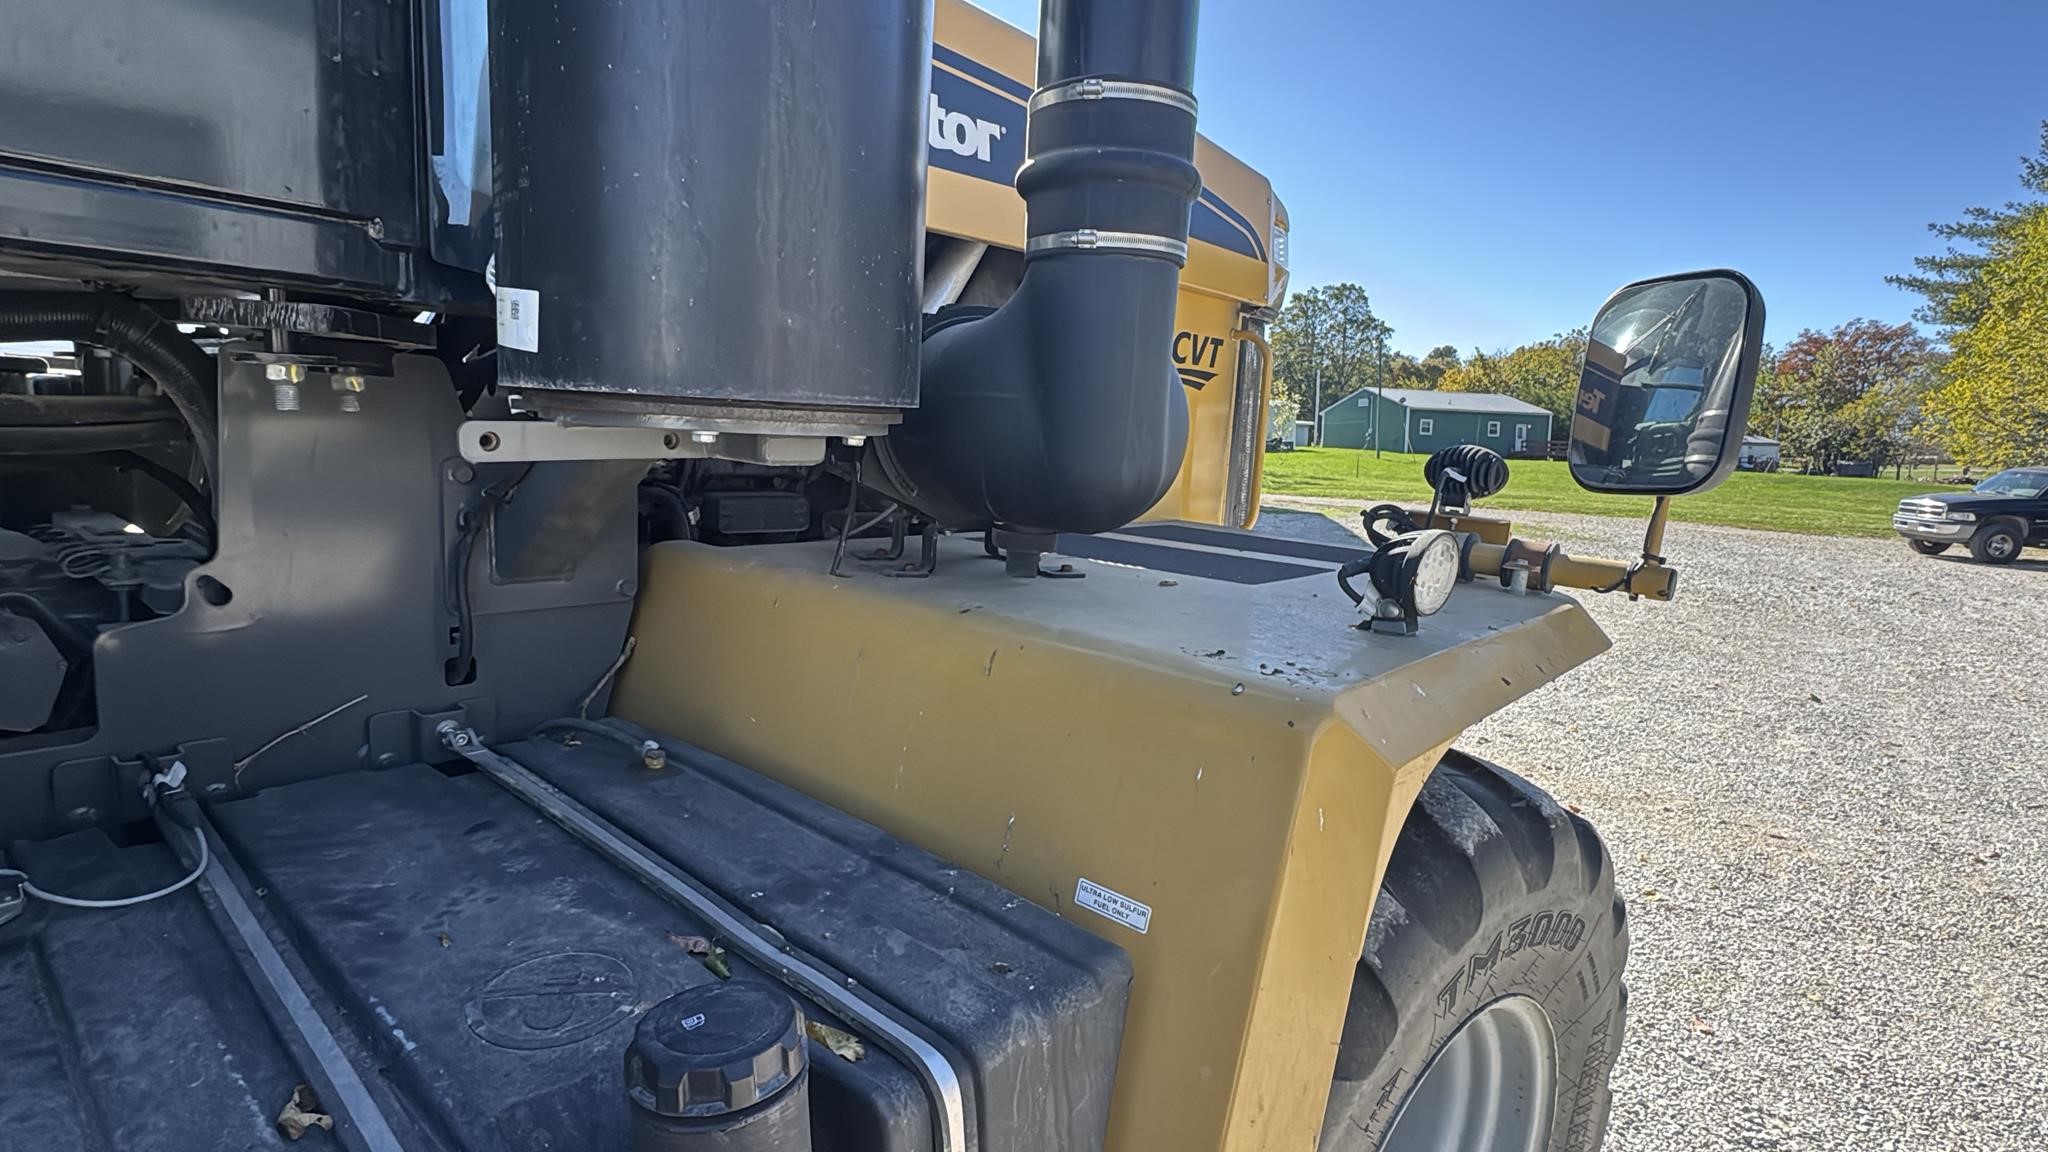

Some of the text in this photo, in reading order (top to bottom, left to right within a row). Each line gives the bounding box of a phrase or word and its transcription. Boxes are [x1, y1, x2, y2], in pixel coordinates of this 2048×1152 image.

[928, 92, 1001, 162] tor
[1172, 331, 1224, 368] CVT
[1081, 885, 1147, 918] ULTRA LOW SULFUR
[1093, 899, 1130, 919] FUEL ONLY
